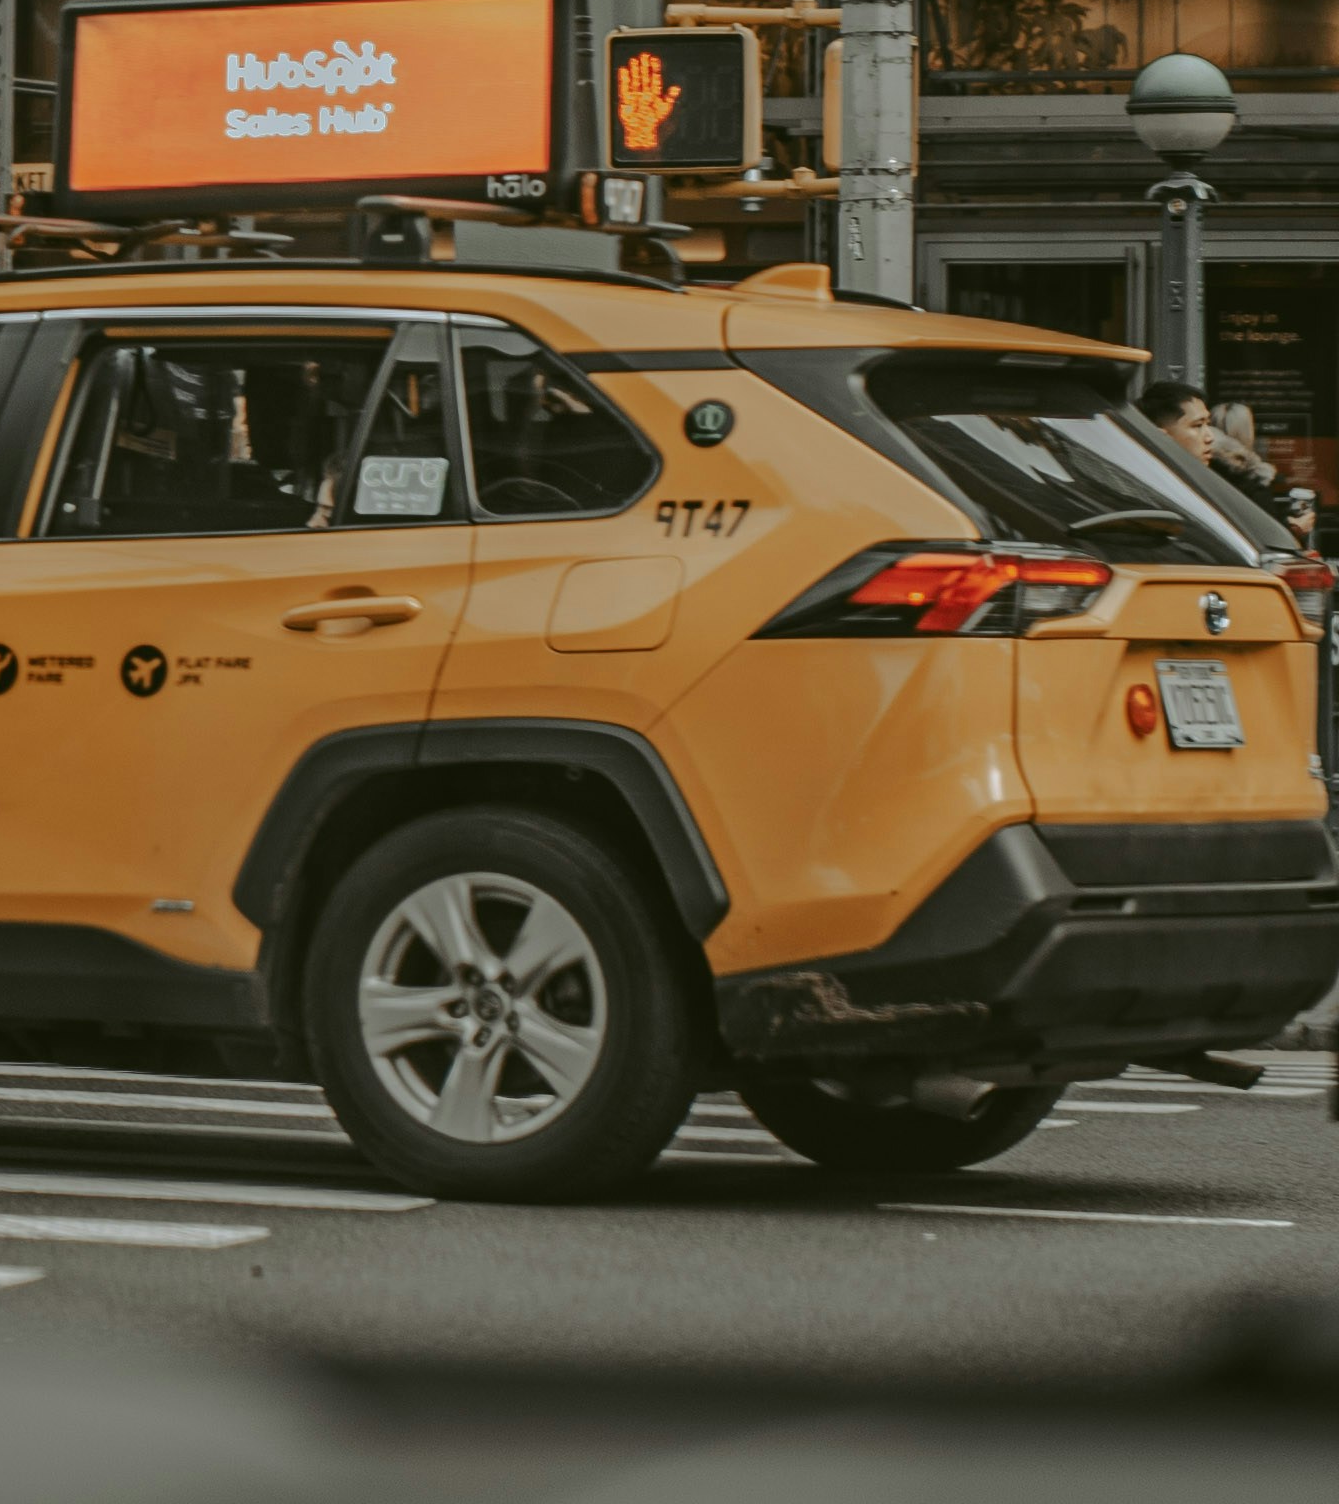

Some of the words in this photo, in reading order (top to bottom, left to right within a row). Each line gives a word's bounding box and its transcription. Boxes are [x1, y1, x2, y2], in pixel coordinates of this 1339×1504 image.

[225, 39, 398, 95] HubSpot
[225, 107, 312, 139] Sales
[361, 460, 443, 489] curb
[655, 499, 752, 538] 9T47
[26, 655, 96, 669] METERED
[176, 656, 212, 670] FLAT
[215, 656, 253, 670] FARE
[26, 672, 64, 685] FARE
[176, 673, 203, 687] JFK
